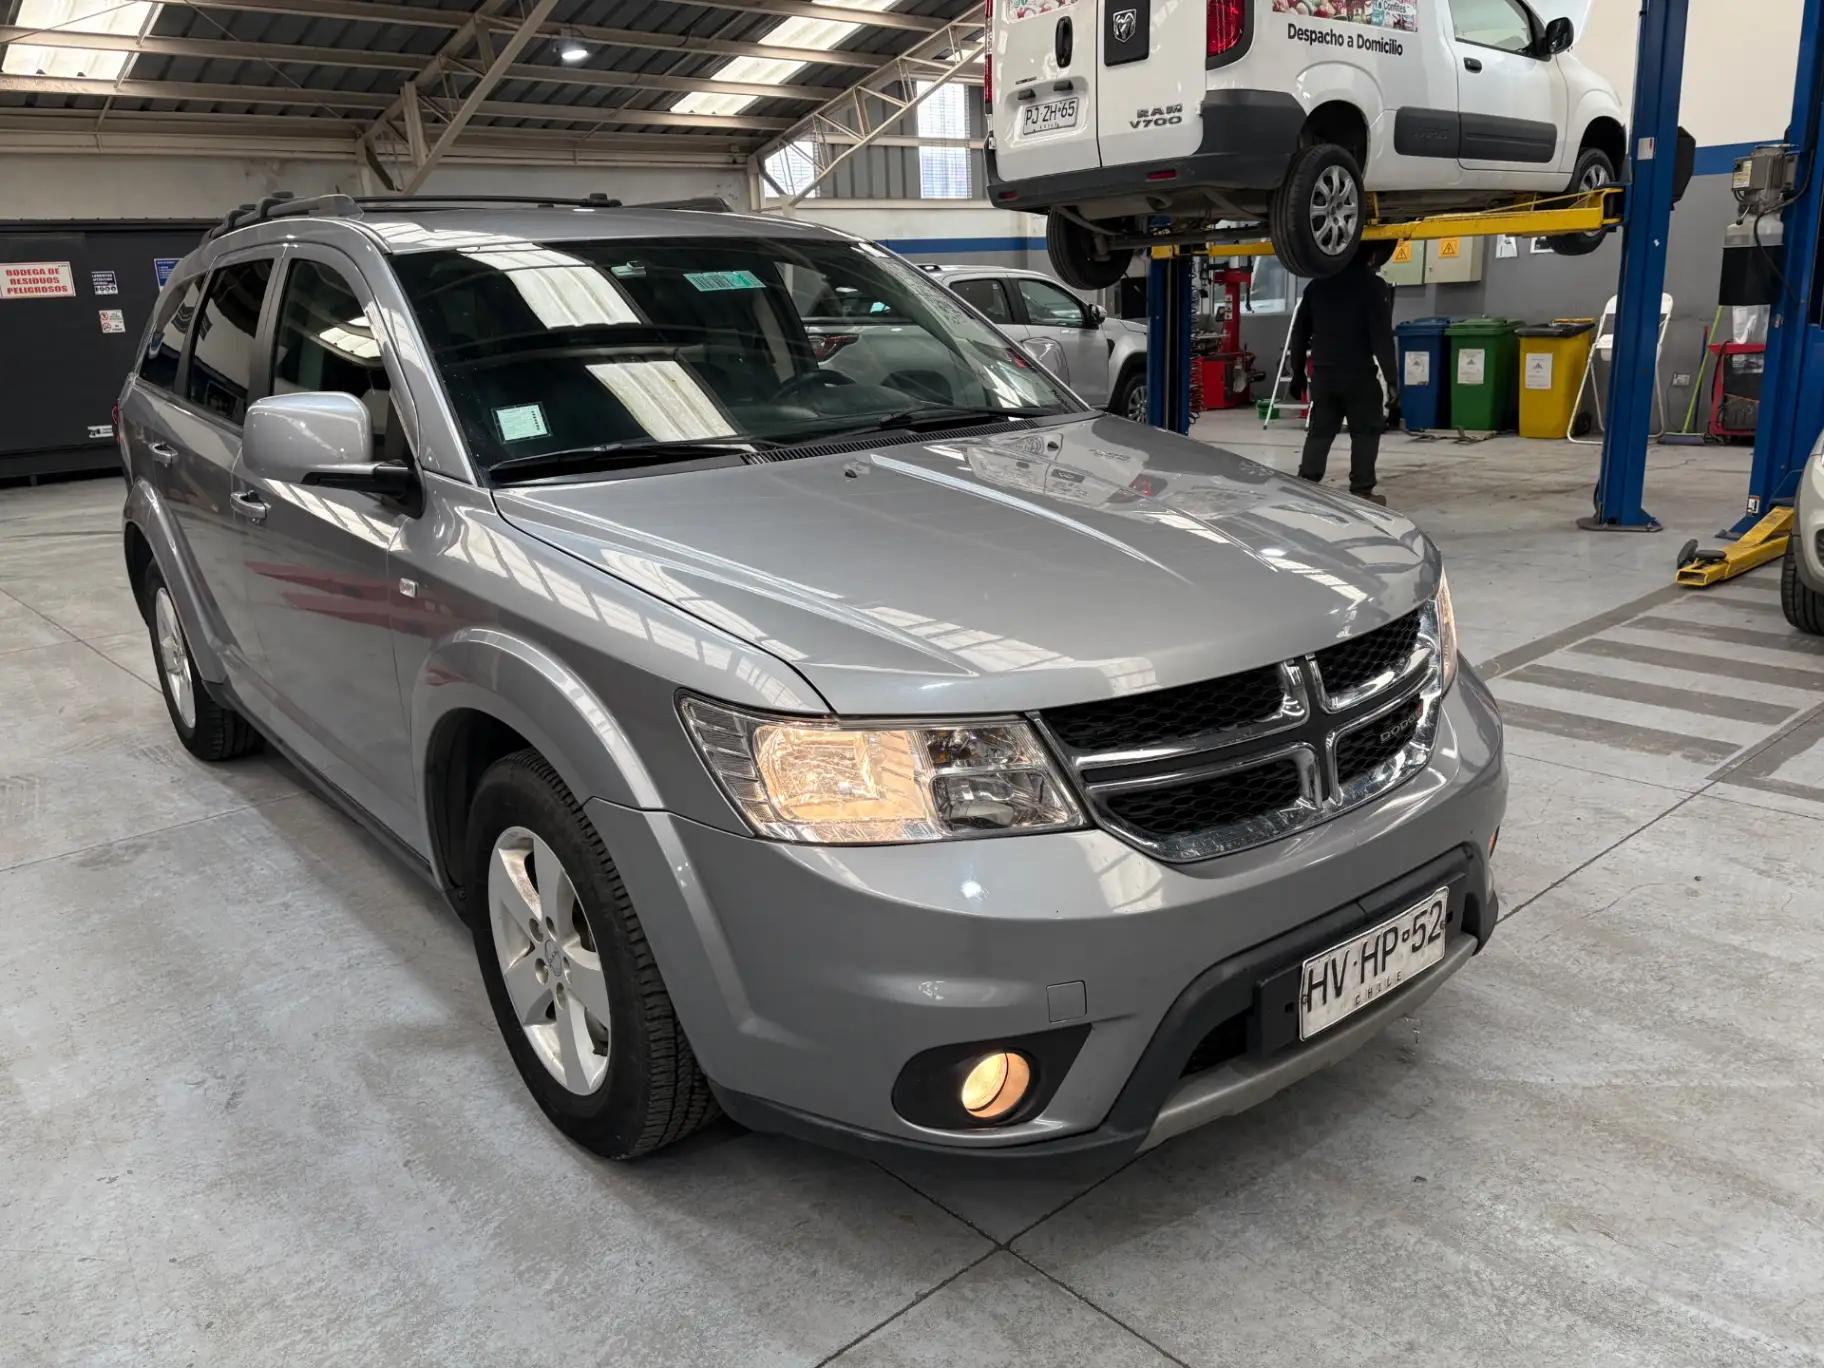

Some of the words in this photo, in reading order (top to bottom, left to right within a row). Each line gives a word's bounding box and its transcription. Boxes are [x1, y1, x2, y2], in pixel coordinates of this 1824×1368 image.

[1287, 22, 1345, 46] Despacho
[1346, 35, 1354, 48] a
[1356, 33, 1404, 56] Domicilio
[1136, 103, 1183, 119] RAM
[1129, 116, 1183, 129] V700
[5, 268, 46, 276] BODEGA
[47, 267, 60, 275] DE
[10, 277, 60, 285] RESIDUOS
[7, 285, 69, 294] PELIGROSOS
[1355, 970, 1402, 1006] CHILE
